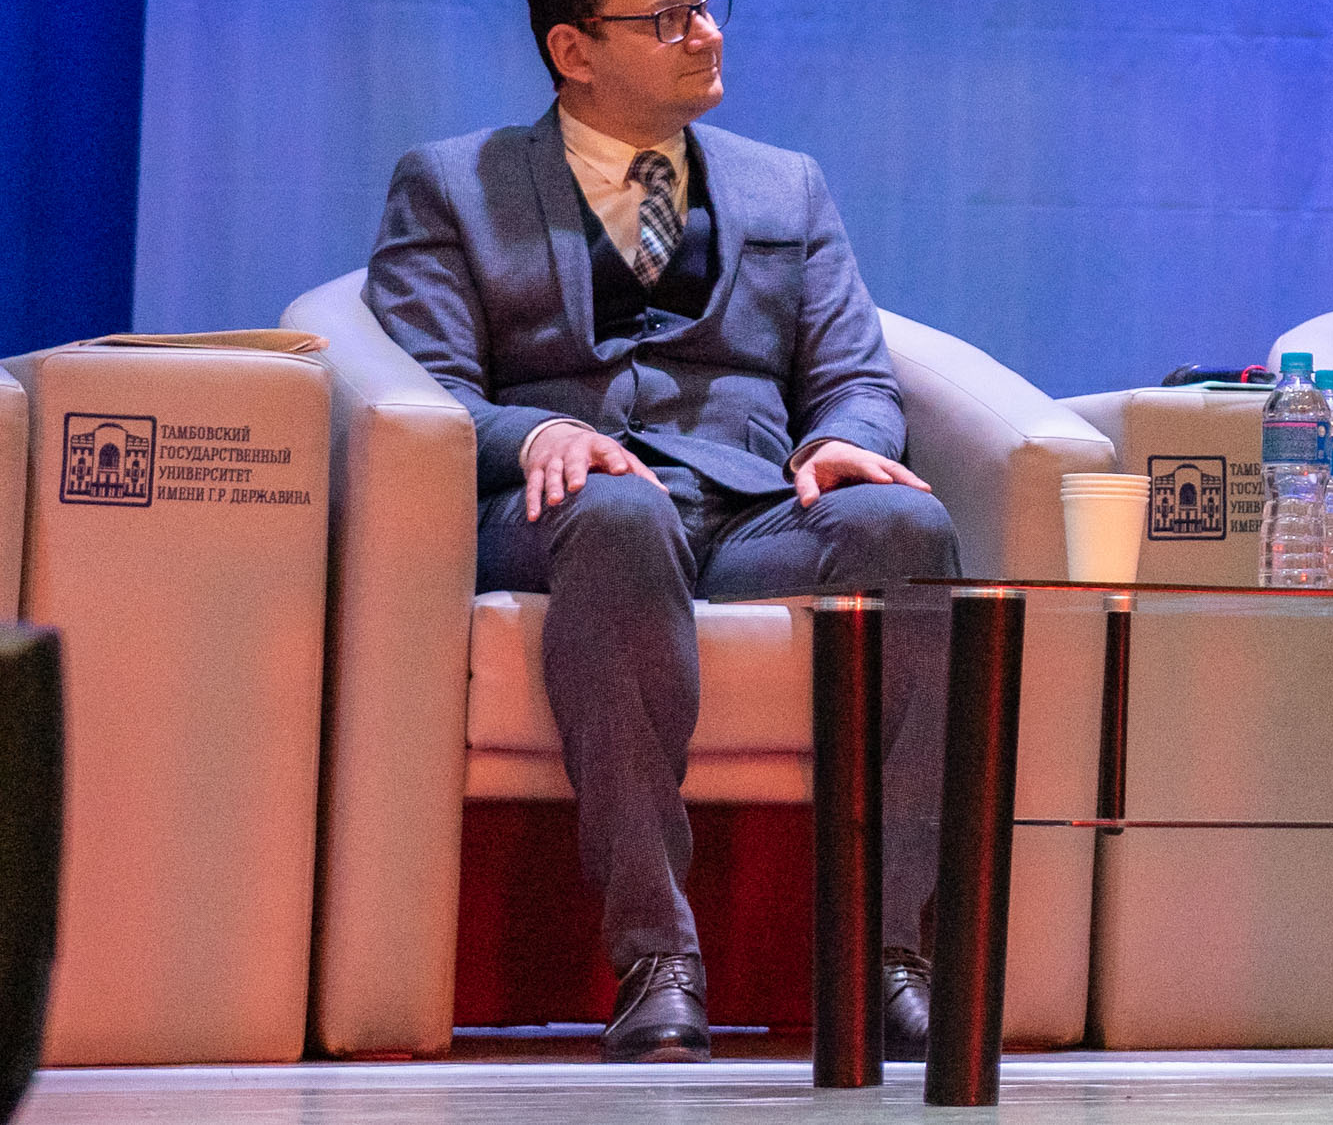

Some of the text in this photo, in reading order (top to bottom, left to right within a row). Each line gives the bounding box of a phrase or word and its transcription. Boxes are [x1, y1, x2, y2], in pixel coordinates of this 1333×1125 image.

[160, 425, 251, 442] ТАМБОВСКИЙ
[159, 445, 291, 464] ГОСУДАРСТВЕННЫЙ
[158, 466, 252, 482] УНИВЕРСИТЕТ
[157, 486, 205, 501] ИМЕНИ
[230, 488, 311, 505] ДЕРЖАВИНА
